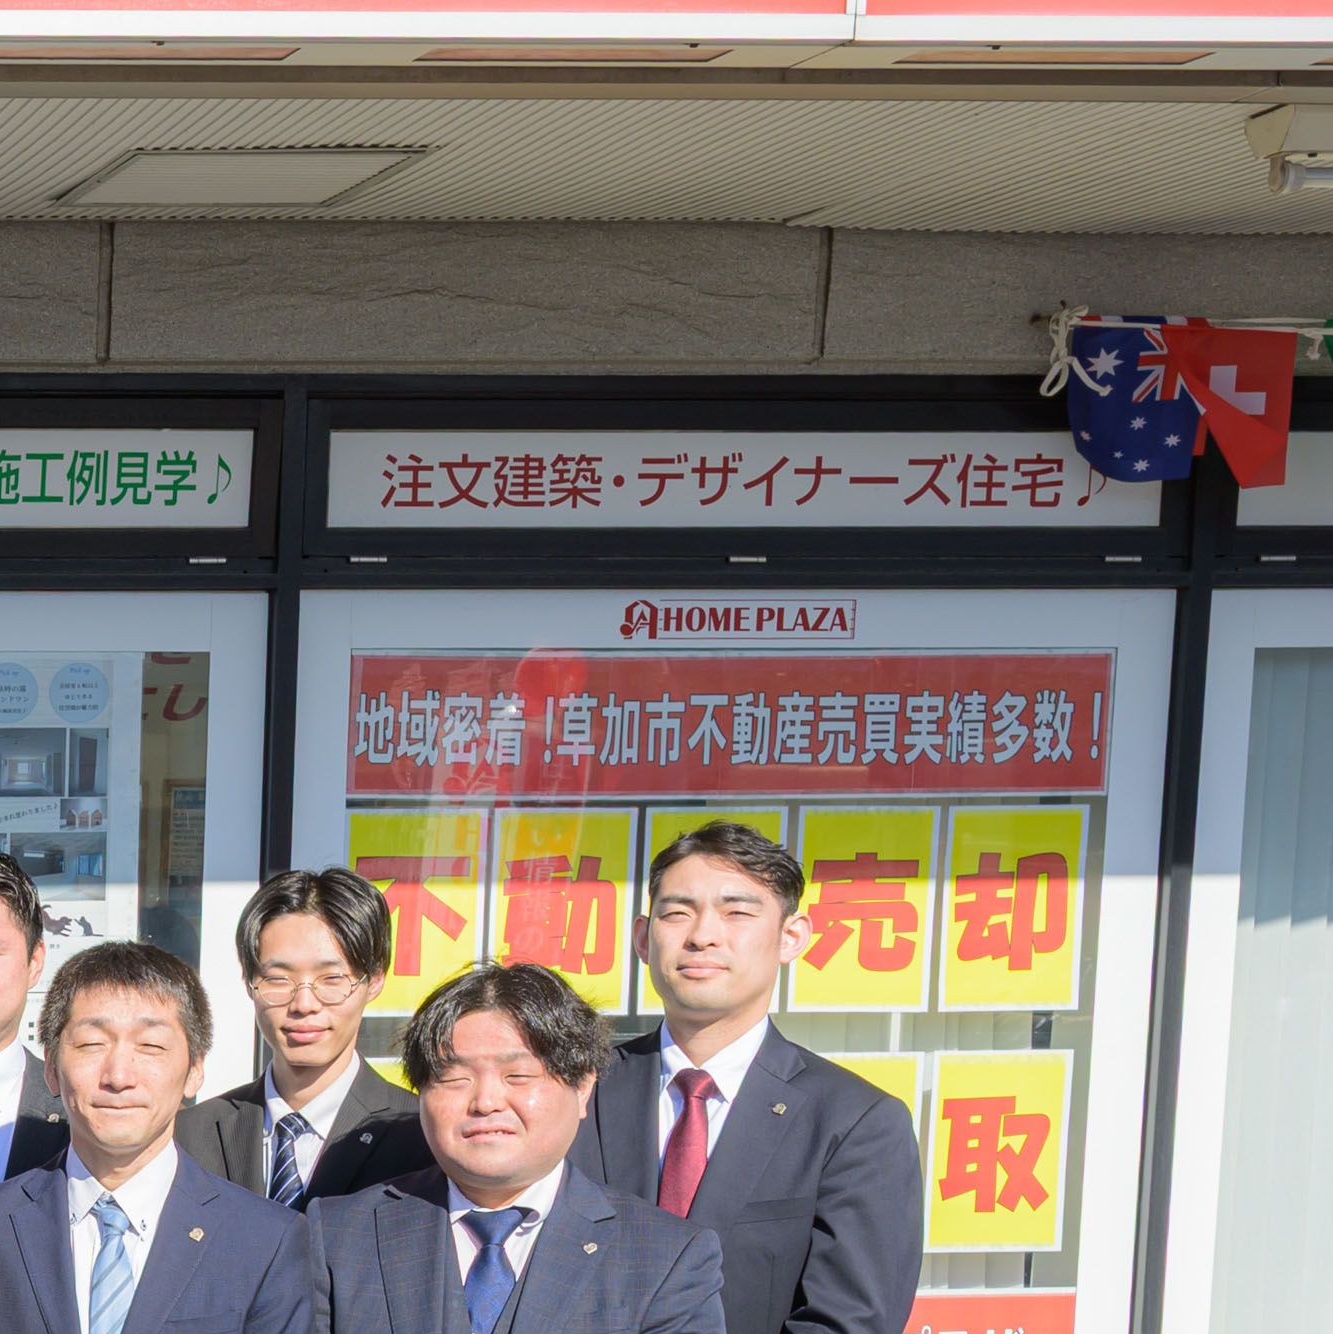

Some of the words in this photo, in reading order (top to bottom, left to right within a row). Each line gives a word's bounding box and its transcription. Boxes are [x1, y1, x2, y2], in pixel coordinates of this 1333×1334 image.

[663, 606, 751, 632] HOME
[755, 607, 848, 632] PLAZA
[938, 1095, 1051, 1213] 取
